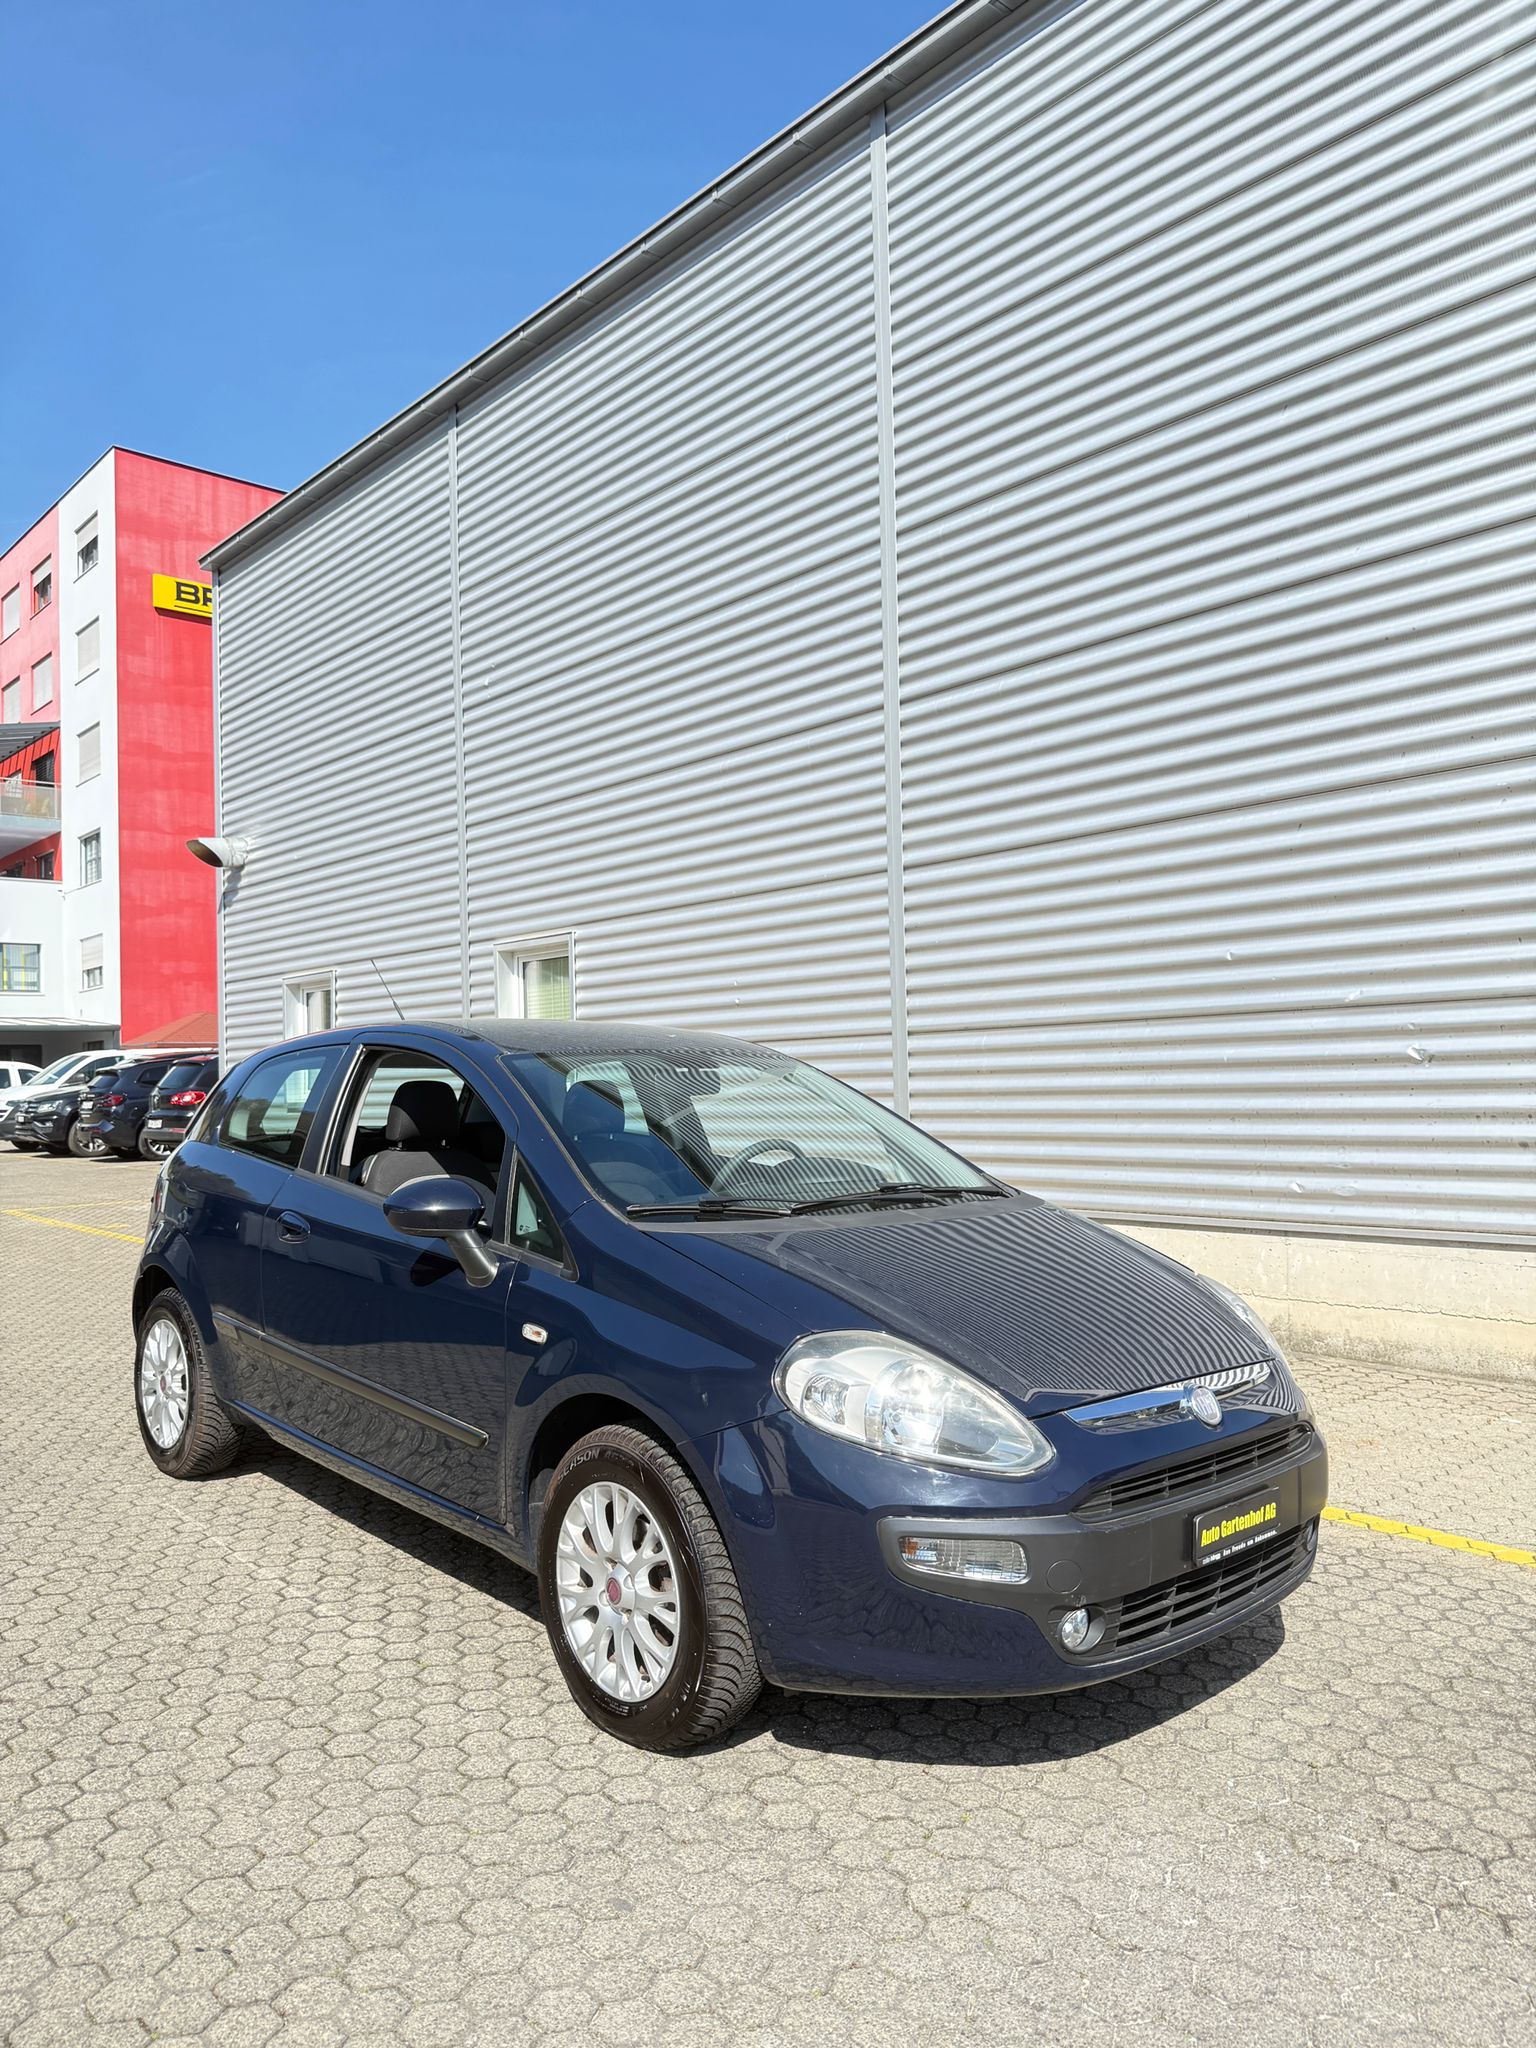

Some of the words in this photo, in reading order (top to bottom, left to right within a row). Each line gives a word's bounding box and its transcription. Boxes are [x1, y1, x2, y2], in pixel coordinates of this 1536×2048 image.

[1201, 1525, 1220, 1547] Auto
[1221, 1506, 1264, 1538] Gartenhof
[1264, 1502, 1277, 1521] AG
